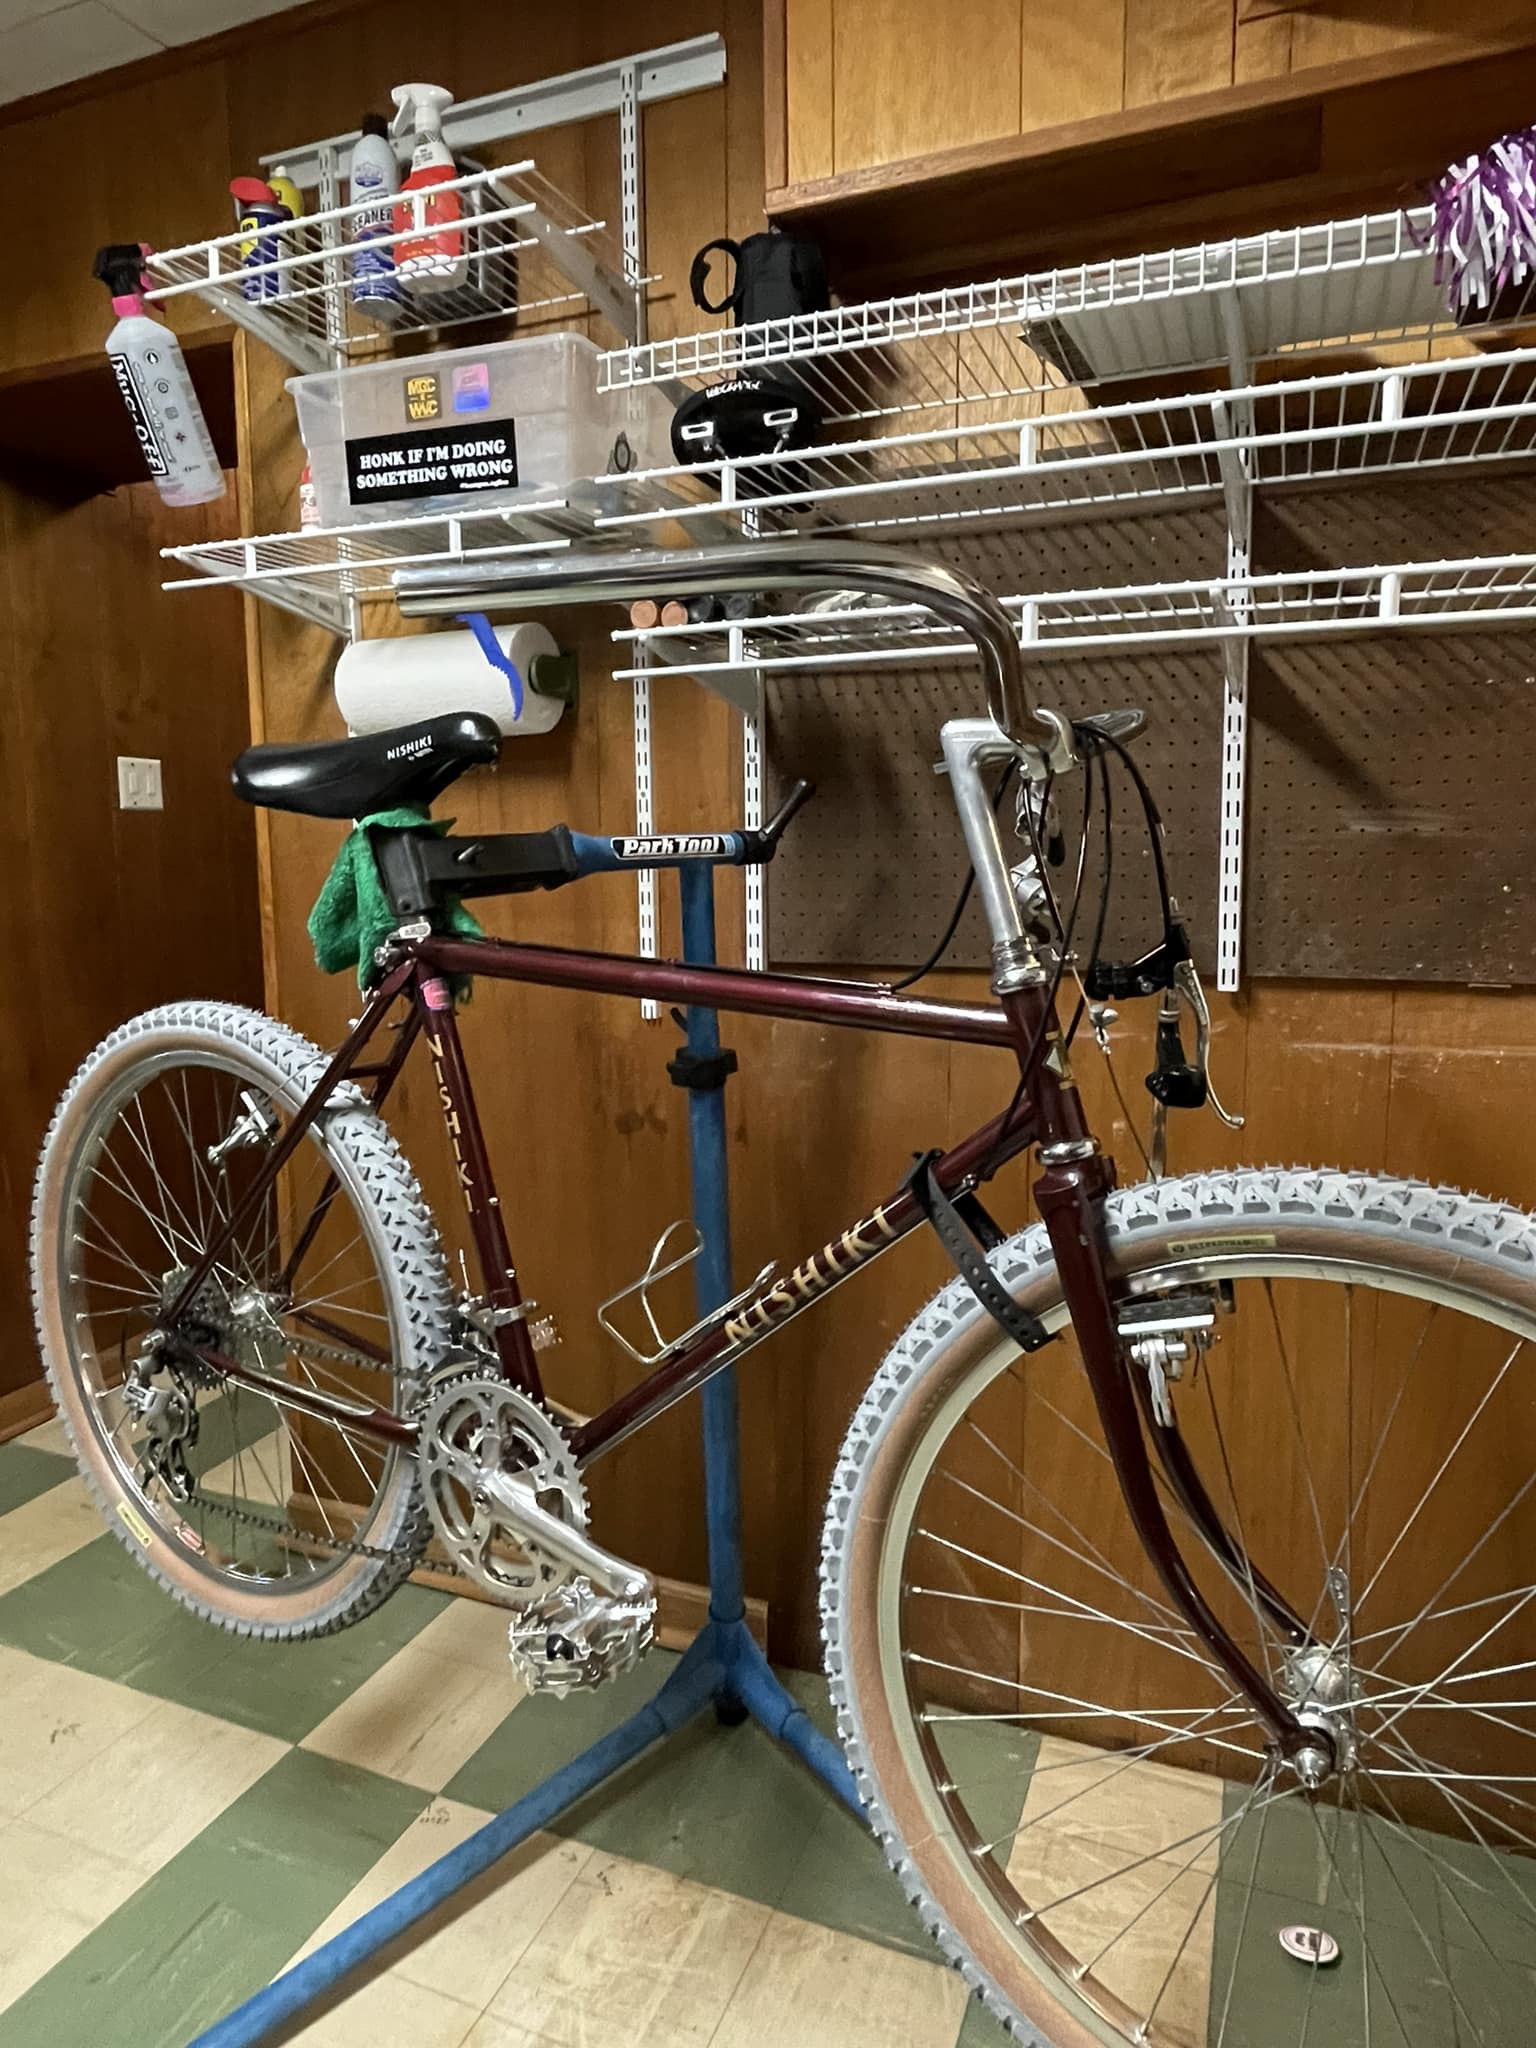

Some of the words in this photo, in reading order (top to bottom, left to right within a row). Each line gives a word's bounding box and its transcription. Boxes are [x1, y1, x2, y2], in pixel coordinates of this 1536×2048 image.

[359, 452, 406, 470] HONK
[408, 449, 424, 464] IF
[426, 445, 449, 461] I'M
[452, 439, 507, 459] DOING
[356, 466, 448, 489] SOMETHING
[450, 459, 514, 479] WRONG
[387, 734, 432, 760] NISHIKI
[725, 1205, 898, 1345] NISHIKI
